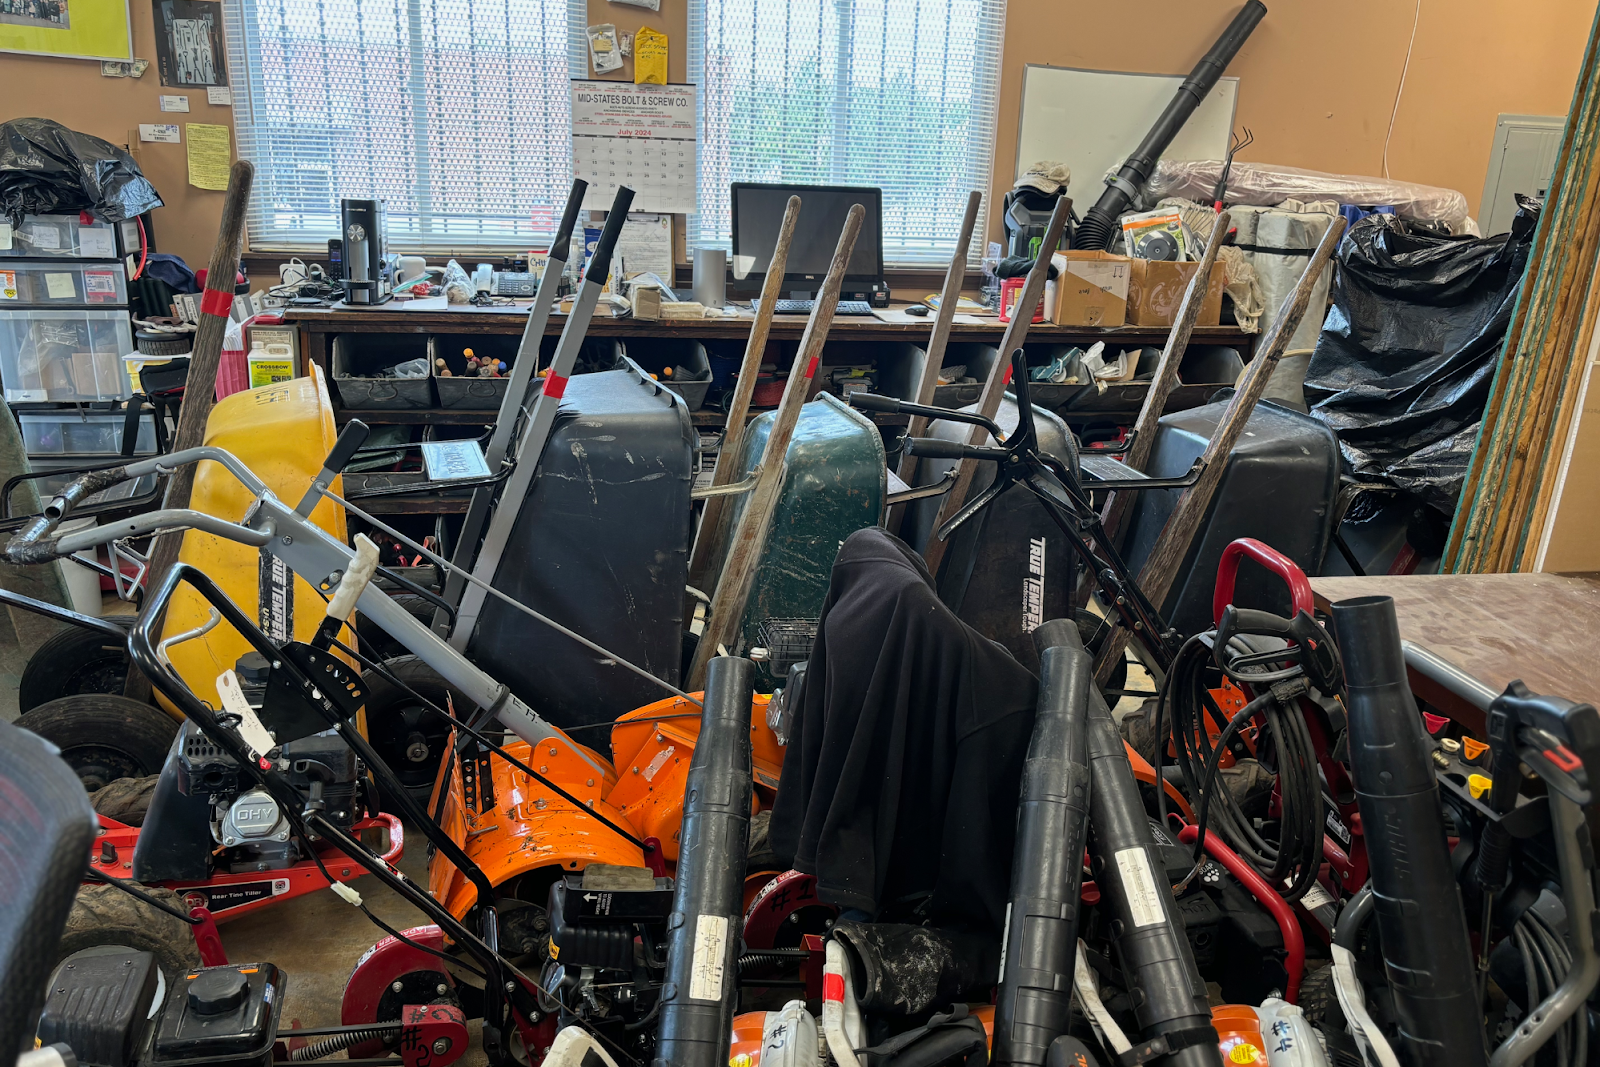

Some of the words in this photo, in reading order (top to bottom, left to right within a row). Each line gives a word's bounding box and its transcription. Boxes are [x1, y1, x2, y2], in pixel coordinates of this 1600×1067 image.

[578, 93, 621, 105] MID-STATES
[622, 95, 640, 105] BOLT
[642, 96, 647, 106] &
[648, 96, 674, 106] SCREW
[675, 98, 688, 107] CO.
[617, 128, 633, 136] July
[272, 554, 287, 587] RUE
[1029, 537, 1046, 577] TRUE
[272, 586, 287, 642] TEMPER
[1028, 576, 1045, 631] TEMPER
[237, 808, 273, 821] OHV
[185, 898, 203, 907] DR
[770, 878, 814, 912] #1
[378, 929, 416, 946] DAGER
[401, 1025, 432, 1067] #2
[1270, 1020, 1293, 1054] #4
